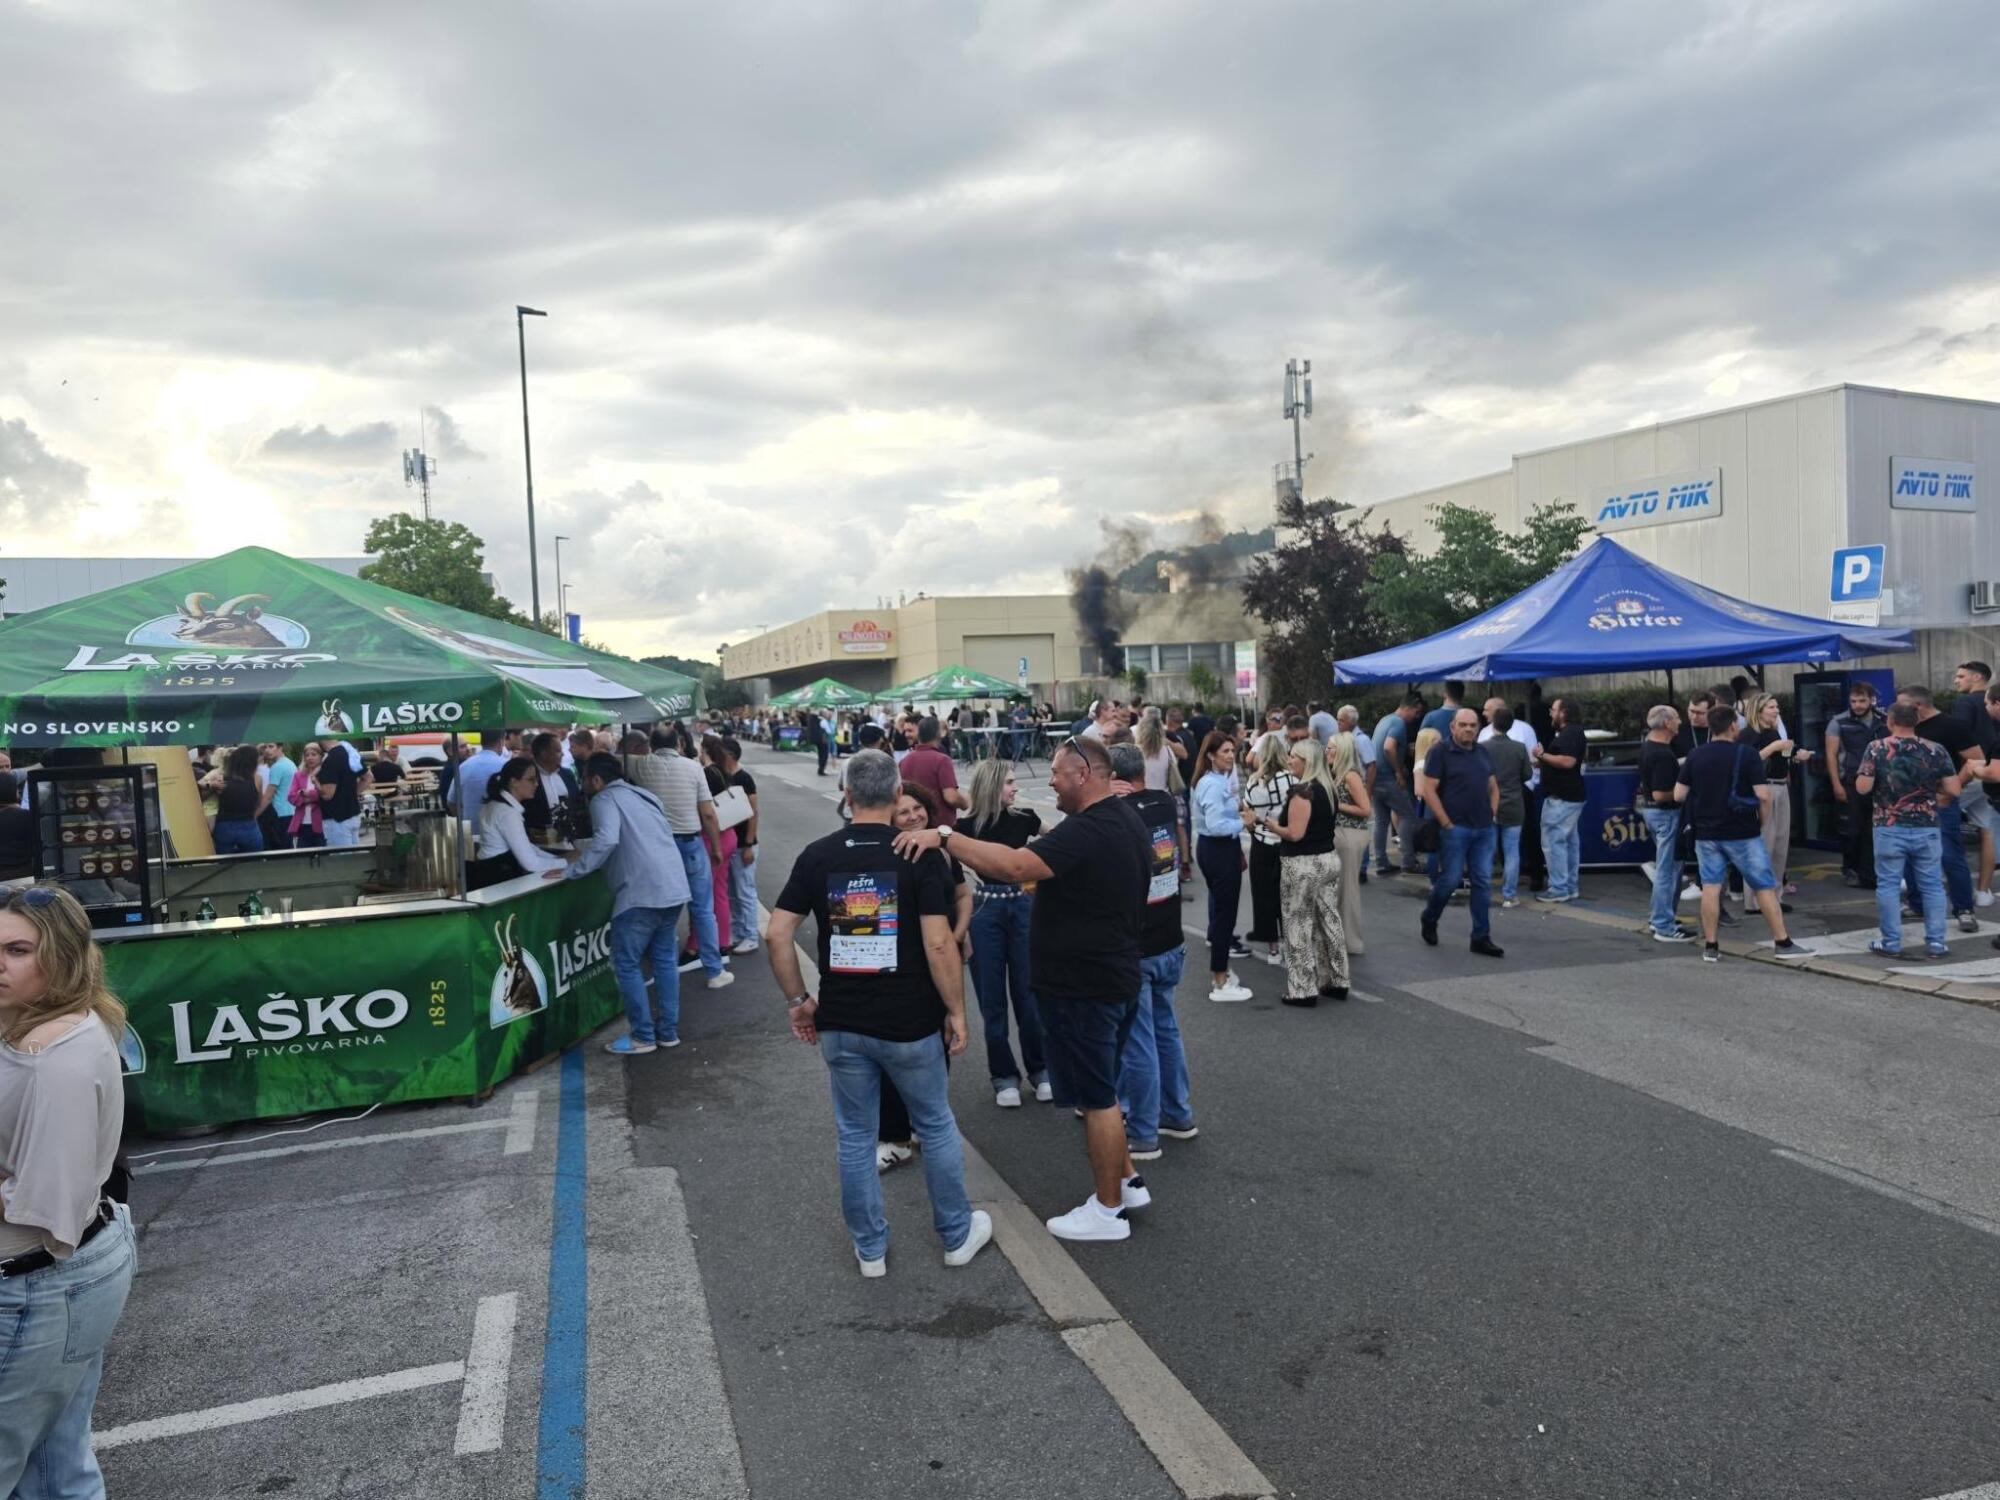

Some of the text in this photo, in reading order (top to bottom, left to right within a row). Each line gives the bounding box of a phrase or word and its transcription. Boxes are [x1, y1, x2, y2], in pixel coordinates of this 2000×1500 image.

[1895, 470, 1973, 498] AVTO MIK
[1597, 480, 1714, 521] AVTO MIK
[1842, 554, 1871, 595] P
[61, 645, 338, 672] LAŠKO
[145, 662, 306, 672] PIVOVARNA
[163, 677, 236, 686] 1825
[3, 720, 181, 735] NO SLOVENSKO
[361, 701, 463, 733] LAŠKO
[429, 980, 447, 1027] 1825
[168, 989, 409, 1064] LAŠKO
[246, 1034, 386, 1059] PIVOVARNA
